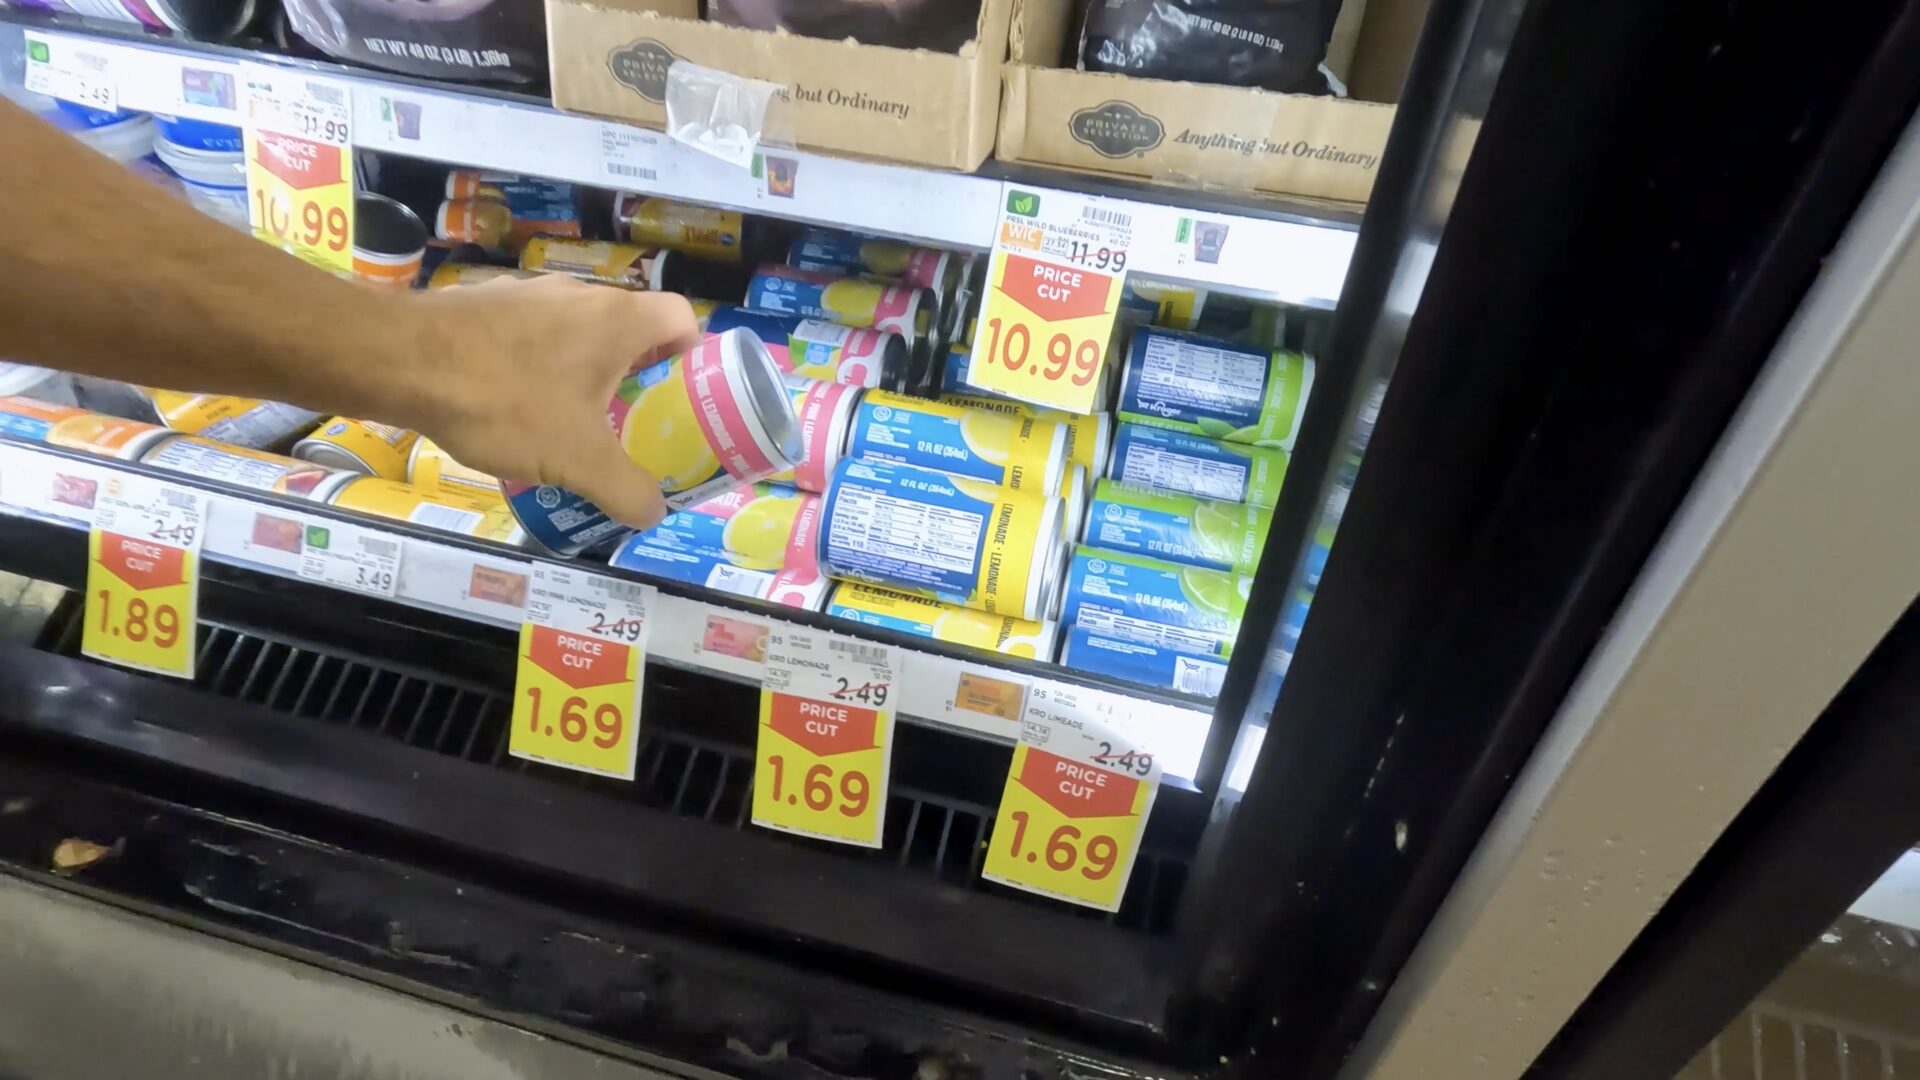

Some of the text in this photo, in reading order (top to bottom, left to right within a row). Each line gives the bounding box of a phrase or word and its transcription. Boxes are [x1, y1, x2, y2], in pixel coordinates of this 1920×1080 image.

[363, 37, 388, 54] NET
[386, 39, 409, 58] WT
[424, 44, 443, 62] OZ
[795, 83, 822, 103] but
[827, 88, 910, 119] Ordinary
[304, 115, 349, 143] 11.99
[1083, 127, 1150, 142] SELECTION
[1086, 119, 1147, 133] PRIVATE
[278, 137, 318, 158] PRICE
[1173, 128, 1256, 155] Anything
[1292, 140, 1378, 169] Ordinary
[284, 157, 312, 173] CUT
[256, 189, 348, 252] 10.99
[1027, 218, 1046, 229] WILD
[1048, 224, 1100, 241] BLUEBERRIES
[1008, 224, 1038, 242] WIC
[1071, 241, 1127, 273] 11.99
[1034, 264, 1083, 288] PRICE
[1037, 284, 1071, 303] CUT
[987, 318, 1100, 387] 10.99
[1150, 401, 1182, 418] Kroger
[925, 441, 932, 453] FL
[900, 478, 908, 487] 12
[908, 479, 916, 489] FL
[917, 481, 928, 491] OZ
[994, 503, 1014, 545] LEMONADE
[121, 539, 162, 559] PRICE
[125, 557, 154, 573] CUT
[986, 552, 1002, 596] LEMONADE
[355, 567, 391, 590] 3.49
[854, 583, 941, 609] LEMONADE
[98, 589, 180, 648] 1.89
[592, 612, 641, 641] 2.49
[557, 635, 602, 656] PRICE
[771, 635, 783, 645] 95
[562, 653, 594, 670] CUT
[787, 657, 830, 671] LEMONADE
[833, 677, 888, 706] 2.49
[1033, 688, 1047, 699] 95
[527, 687, 622, 749] 1.69
[800, 702, 848, 722] PRICE
[1029, 707, 1085, 731] KRO LIMEADE
[805, 721, 839, 737] CUT
[1094, 741, 1152, 776] 2.49
[1055, 761, 1108, 787] PRICE
[768, 755, 870, 817] 1.69
[1059, 780, 1095, 800] CUT
[1010, 811, 1118, 881] 1.69
